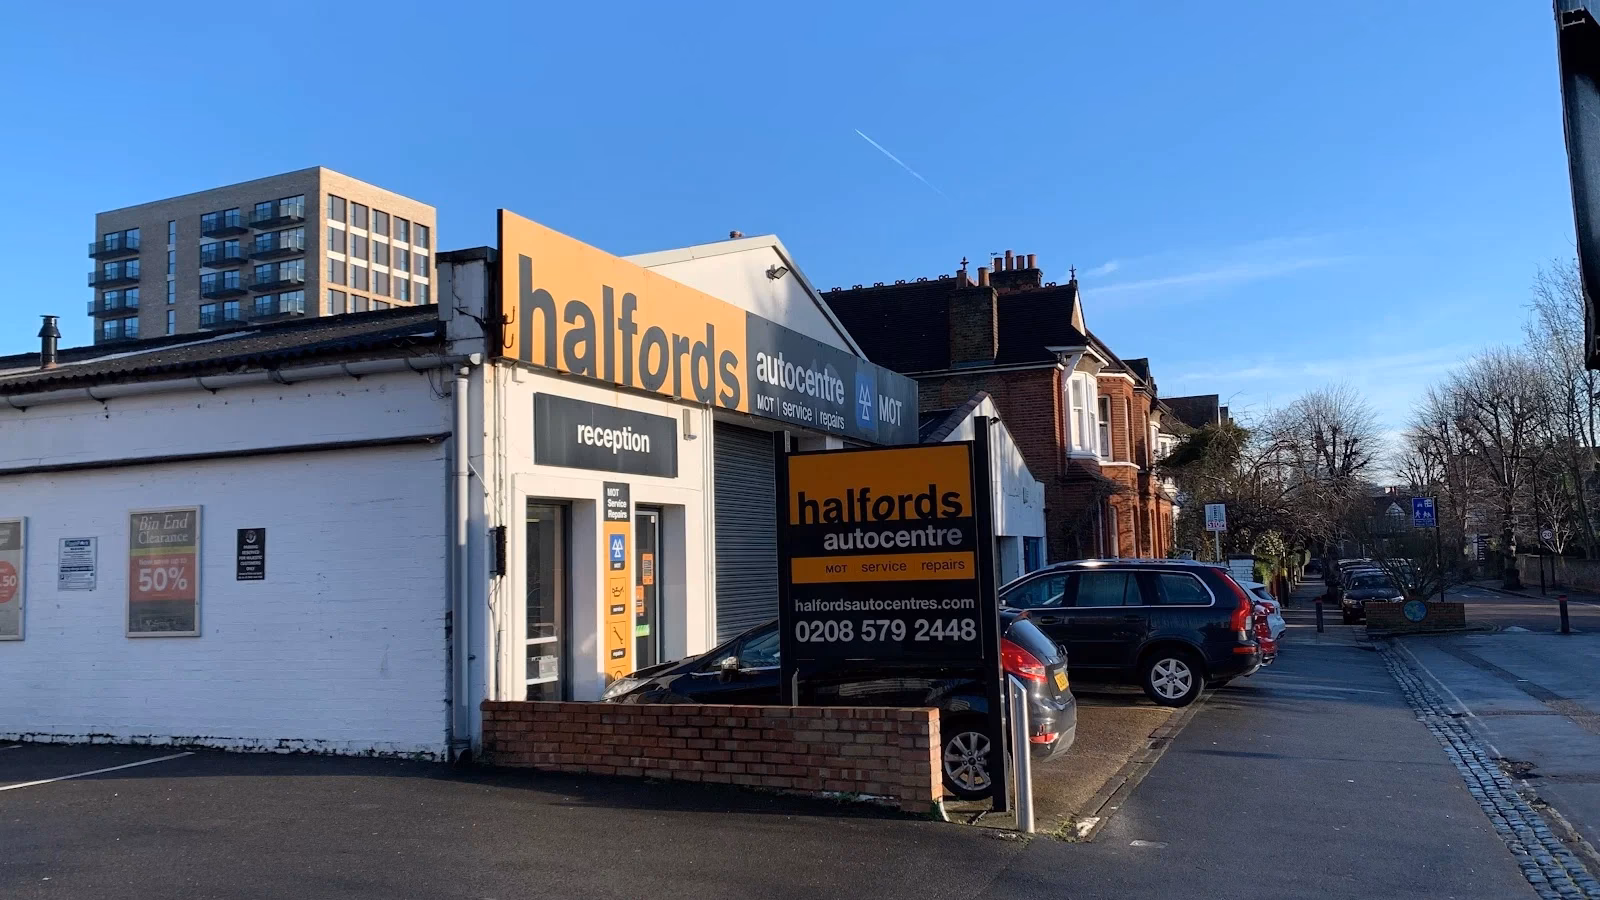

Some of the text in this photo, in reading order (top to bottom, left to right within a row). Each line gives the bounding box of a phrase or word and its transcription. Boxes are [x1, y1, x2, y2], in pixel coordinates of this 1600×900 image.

[518, 253, 741, 411] halfords
[756, 351, 845, 405] autocentre
[757, 393, 845, 431] MOT service repairs
[878, 394, 902, 427] MOT
[577, 423, 650, 454] reception
[607, 487, 620, 497] MOT
[607, 498, 627, 508] Service
[797, 483, 963, 524] halfords
[139, 512, 189, 531] Bin End
[607, 509, 628, 520] Repairs
[138, 530, 189, 544] Clearance
[823, 525, 963, 550] autocentre
[825, 558, 966, 574] MOT service repairs
[138, 566, 188, 592] 50%
[794, 597, 975, 612] halfordsautocentres.com
[795, 618, 977, 643] 0208 579 2448
